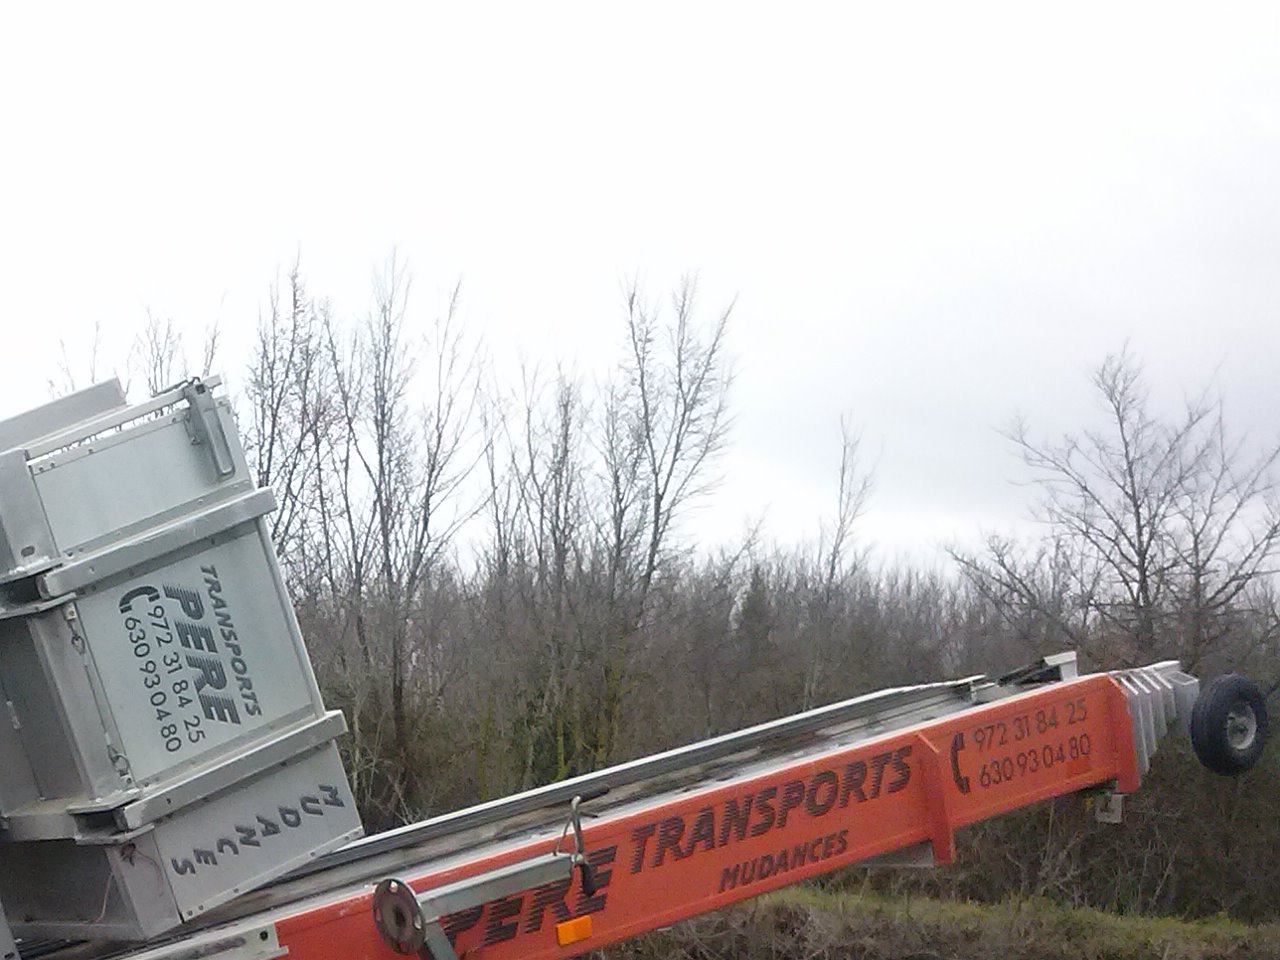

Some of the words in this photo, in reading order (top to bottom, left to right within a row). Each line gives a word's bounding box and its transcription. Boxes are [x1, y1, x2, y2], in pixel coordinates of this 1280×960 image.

[124, 616, 151, 658] 630
[147, 605, 174, 648] 972
[162, 581, 242, 725] PERE
[201, 564, 263, 717] TRANSPORTS
[163, 651, 183, 674] 31
[172, 680, 194, 708] 84
[183, 715, 206, 744] 25
[973, 721, 1008, 751] 972
[1013, 715, 1030, 742] 31
[1036, 705, 1058, 734] 84
[1066, 698, 1088, 725] 25
[170, 784, 346, 876] MUDANCES
[629, 745, 913, 875] TRANSPORTS
[718, 828, 849, 893] MUDANCES
